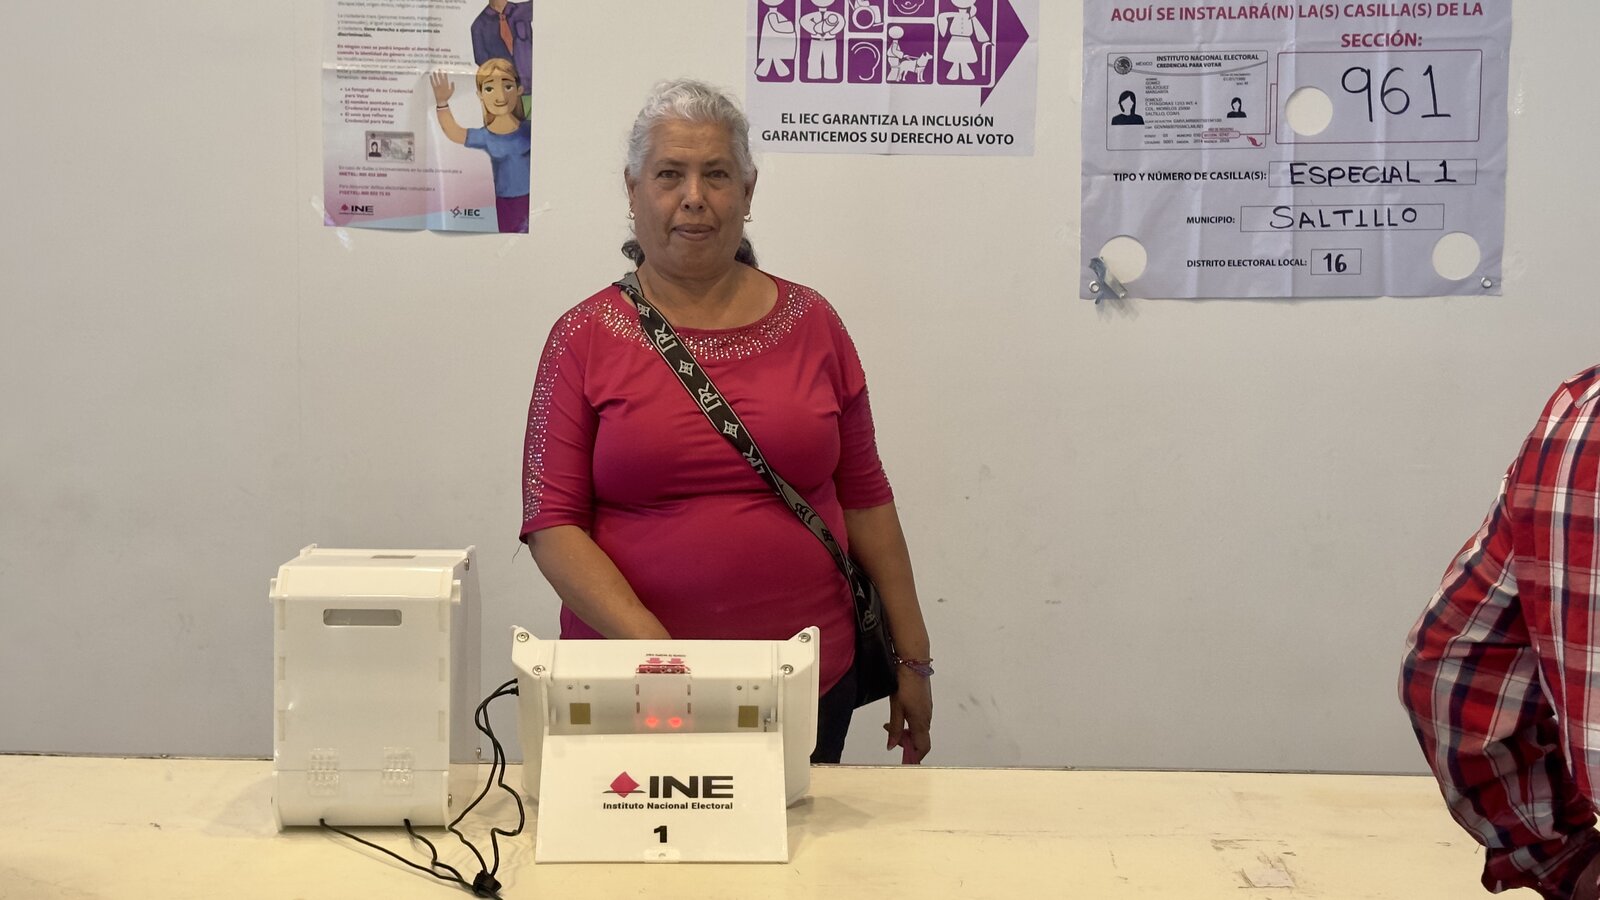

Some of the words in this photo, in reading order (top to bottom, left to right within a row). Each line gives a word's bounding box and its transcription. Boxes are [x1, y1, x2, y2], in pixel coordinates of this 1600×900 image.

[1111, 4, 1153, 22] AQUÍ
[1156, 6, 1176, 20] SE
[1179, 3, 1294, 22] INSTALARÁ(N)
[1298, 4, 1340, 20] LA(S)
[1344, 4, 1432, 19] CASILLA(S)
[1436, 3, 1458, 16] DE
[1462, 3, 1483, 16] LA
[1341, 32, 1422, 48] SECCIÓN:
[1341, 65, 1451, 122] 961
[781, 113, 796, 124] EL
[799, 113, 819, 124] IEC
[822, 114, 898, 126] GARANTIZA
[902, 114, 918, 126] LA
[922, 114, 994, 127] INCLUSIÓN
[762, 131, 867, 143] GARANTICEMOS
[871, 132, 888, 144] SU
[891, 132, 953, 144] DERECHO
[956, 133, 973, 144] AL
[976, 134, 1014, 145] VOTO
[1113, 172, 1136, 182] TIPO
[1138, 172, 1145, 182] Y
[1147, 169, 1192, 182] NÚMERO
[1194, 171, 1208, 181] DE
[1209, 171, 1267, 182] CASILLA(S):
[1289, 160, 1420, 187] ESPECIAL
[1439, 160, 1456, 183] 1
[1186, 214, 1235, 225] MUNICIPIO:
[1270, 206, 1417, 229] SALTILLO
[1187, 258, 1226, 268] DISTRITO
[1228, 258, 1276, 268] ELECTORAL
[1278, 258, 1307, 267] LOCAL:
[1323, 253, 1347, 274] 16
[650, 776, 733, 798] INE
[647, 802, 689, 810] Nacional
[691, 802, 733, 810] Electoral
[653, 826, 667, 843] 1
